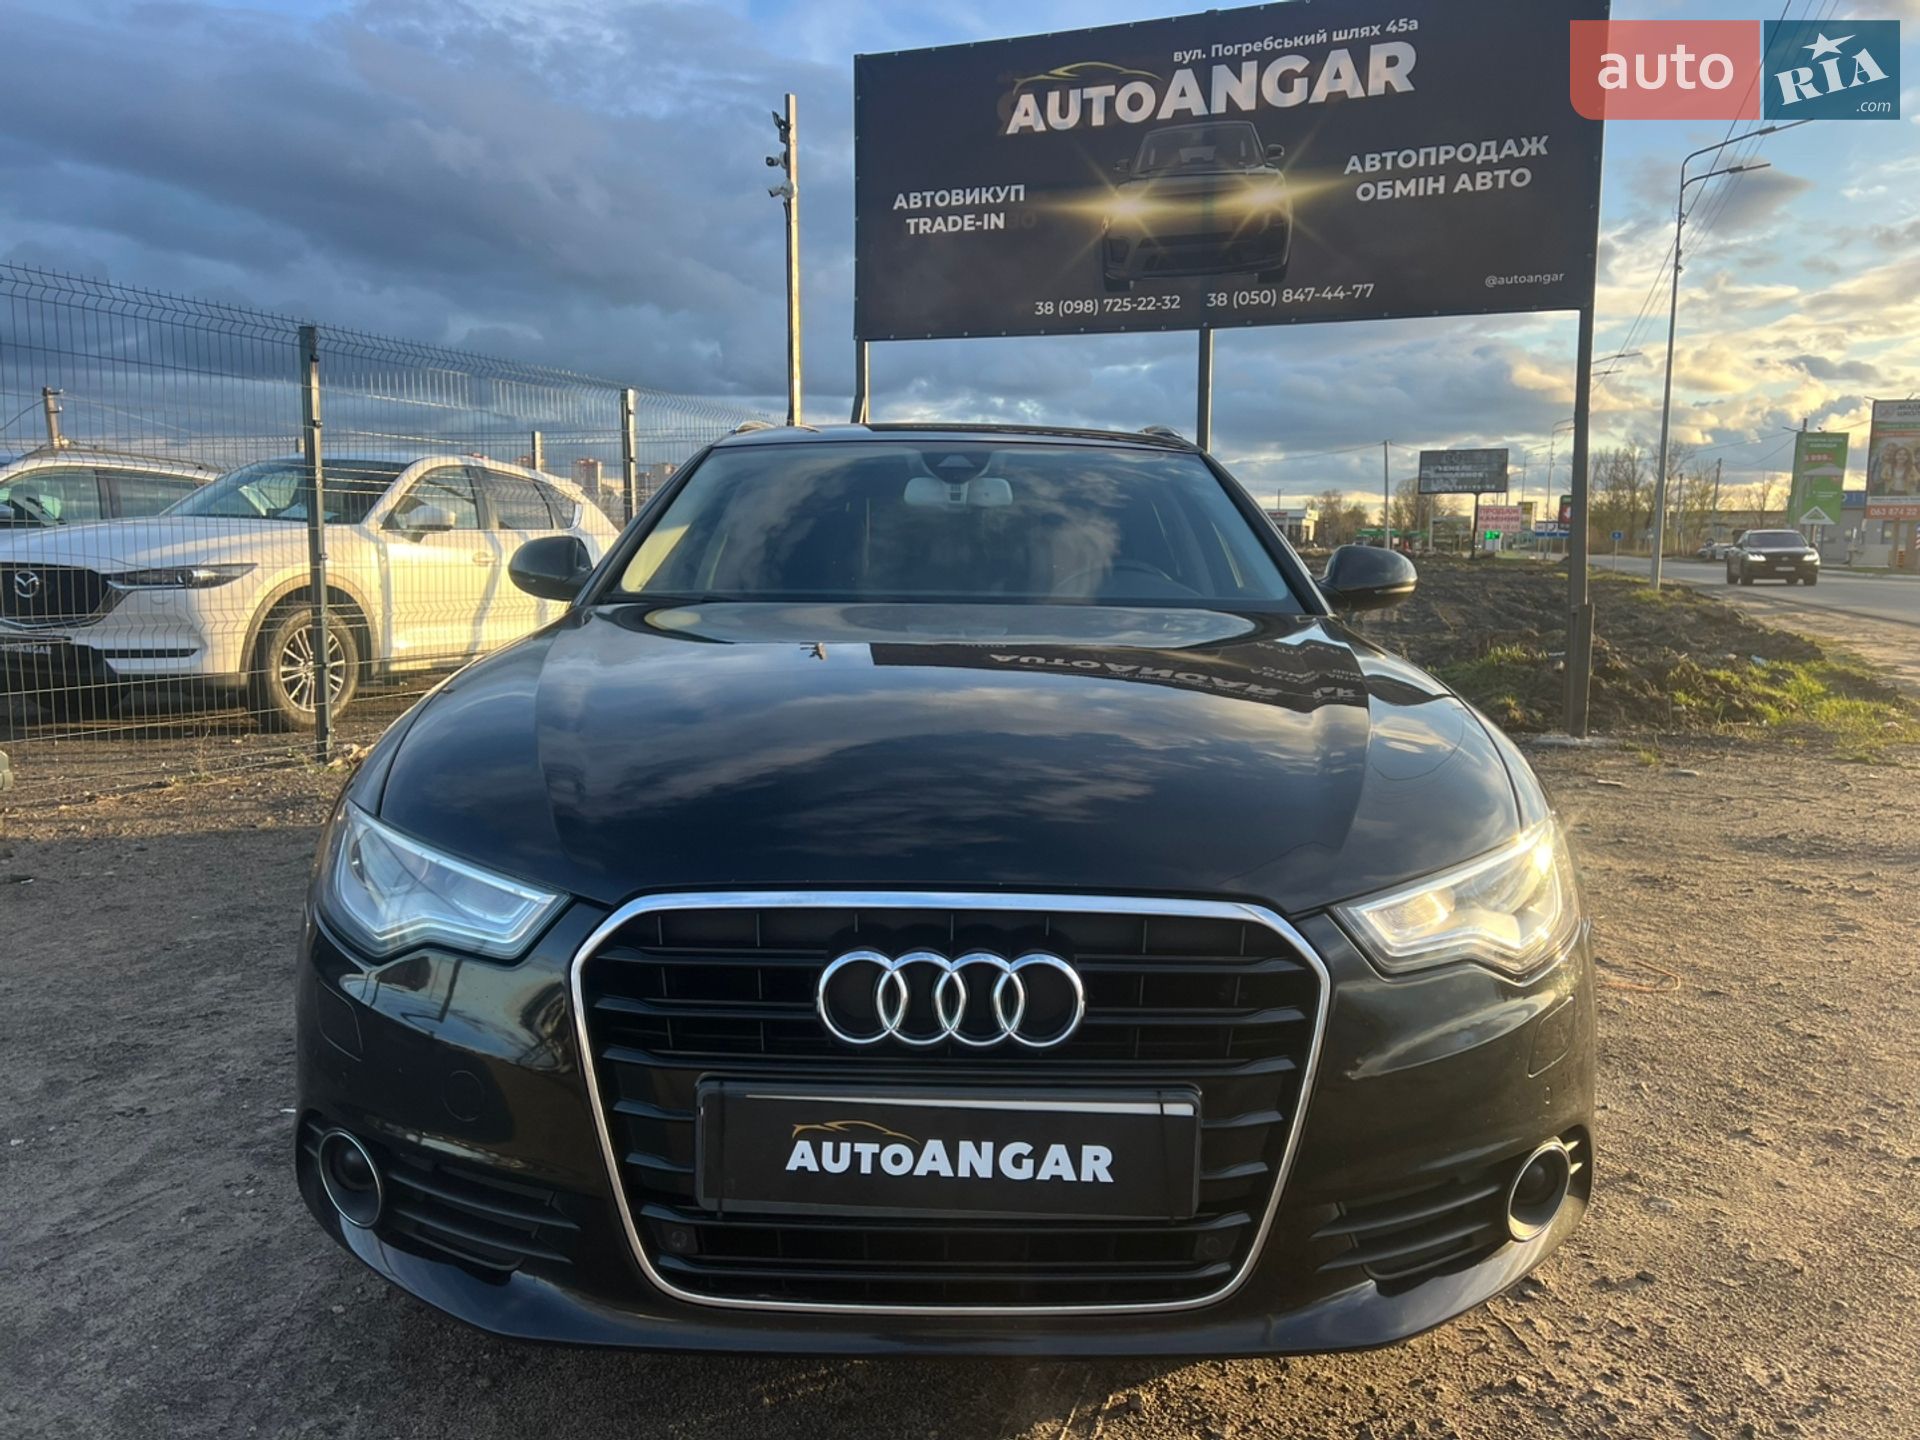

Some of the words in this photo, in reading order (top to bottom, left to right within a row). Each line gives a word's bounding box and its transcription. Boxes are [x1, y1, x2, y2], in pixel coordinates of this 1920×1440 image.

[1173, 49, 1206, 64] вул.
[1211, 30, 1327, 58] Погребський
[1332, 23, 1380, 42] шлях
[1385, 18, 1419, 34] 45а
[1006, 41, 1417, 134] AUTOANGAR
[1344, 135, 1549, 175] АВТОПРОДАЖ
[893, 184, 1025, 210] АВТОВИКУП
[1356, 175, 1446, 201] ОБМІН
[1453, 167, 1532, 193] АВТО
[905, 212, 1006, 235] TRADE-IN
[1206, 293, 1228, 307] 38
[1233, 289, 1277, 308] (050)
[1282, 283, 1375, 303] 847-44-77
[1485, 273, 1565, 288] @autoangar
[1034, 301, 1054, 315] 38
[1058, 299, 1099, 316] (098)
[1103, 295, 1181, 313] 725-22-32
[785, 1139, 1114, 1182] AUTOANGAR
